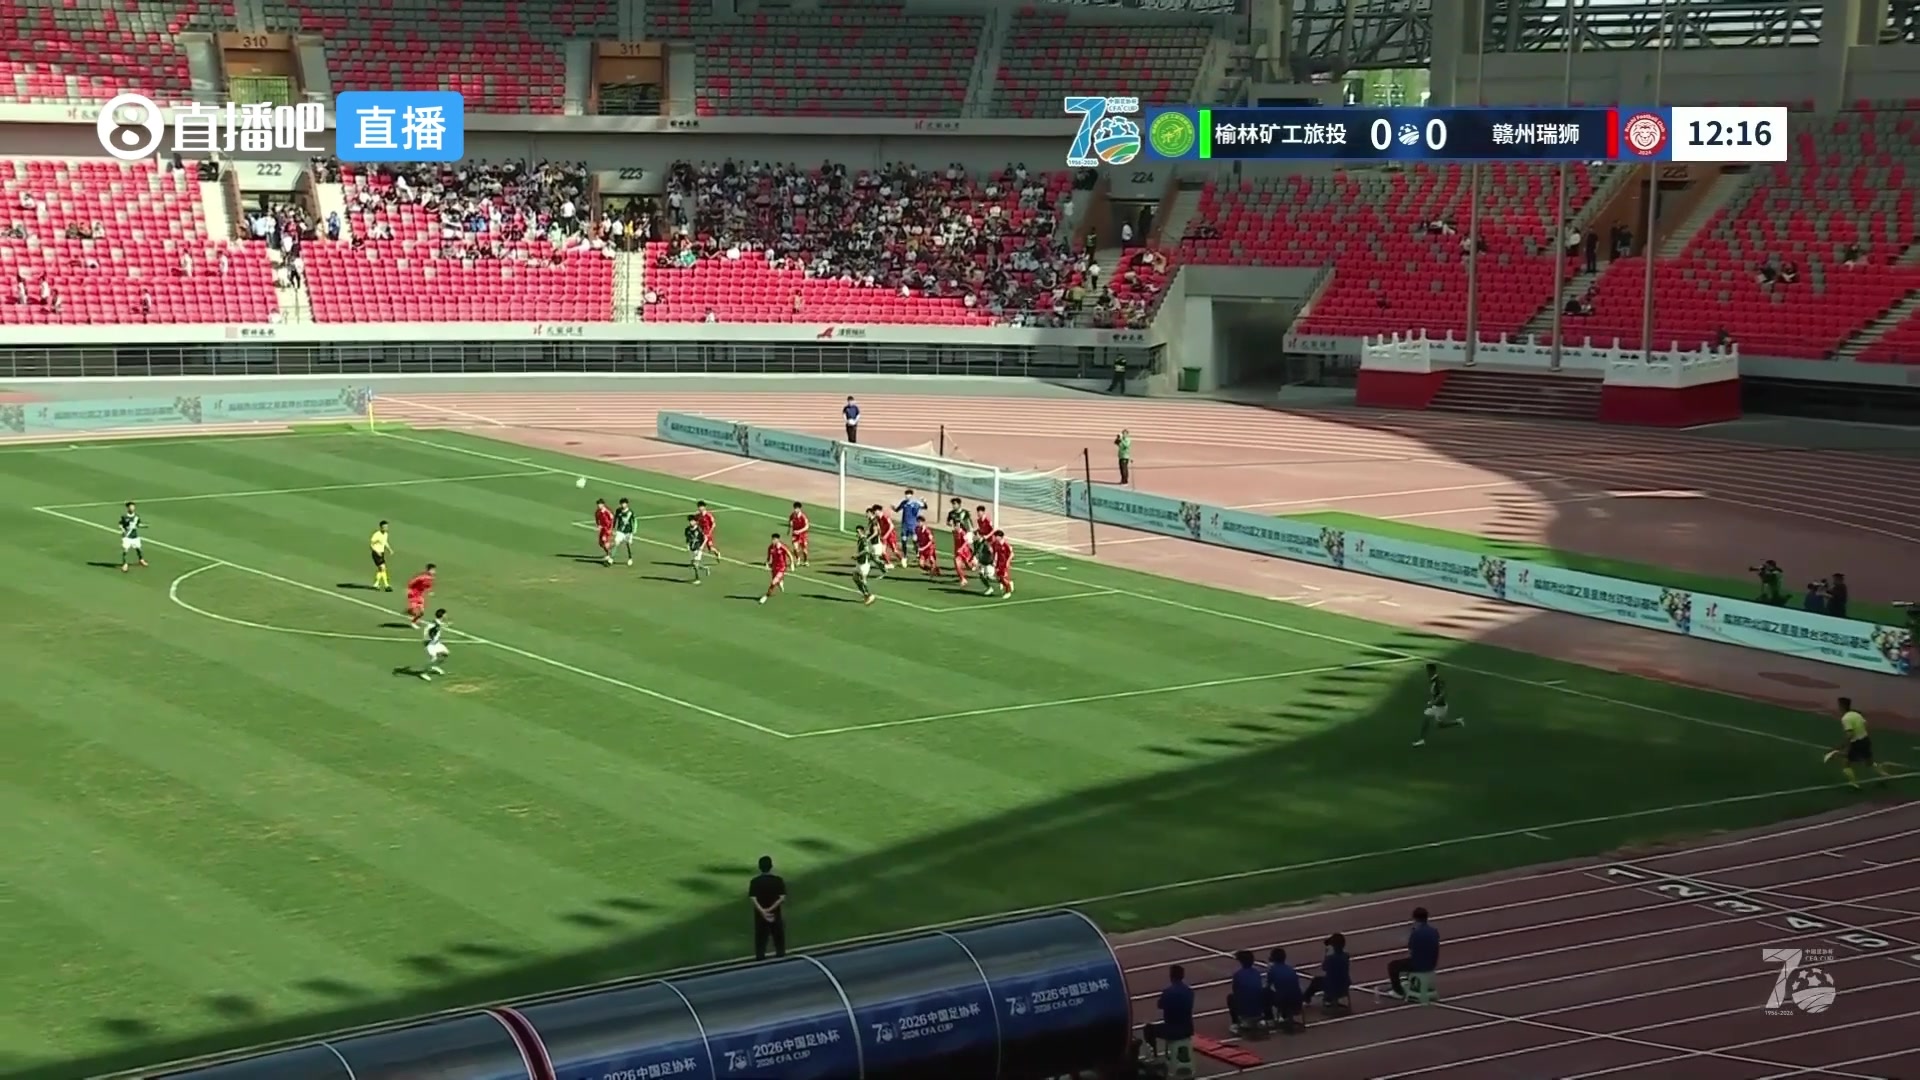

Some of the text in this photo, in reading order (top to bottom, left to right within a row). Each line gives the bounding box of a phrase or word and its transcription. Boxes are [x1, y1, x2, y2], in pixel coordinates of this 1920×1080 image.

[243, 36, 268, 48] 310
[620, 43, 641, 56] 311
[257, 163, 282, 176] 222
[619, 167, 643, 180] 223
[1131, 171, 1154, 184] 224
[1608, 868, 1646, 880] 1
[1658, 884, 1710, 898] 2
[1714, 899, 1763, 913] 3
[1787, 916, 1826, 929] 4
[1836, 933, 1889, 948] 5
[1031, 978, 1110, 1004] 2026中国足协杯
[899, 1002, 981, 1030] 2026中国足协杯
[920, 1026, 936, 1036] CFA
[937, 1022, 954, 1033] CUP
[752, 1029, 840, 1057] 2026中国足协杯
[775, 1053, 792, 1064] CFA
[793, 1049, 811, 1060] CUP
